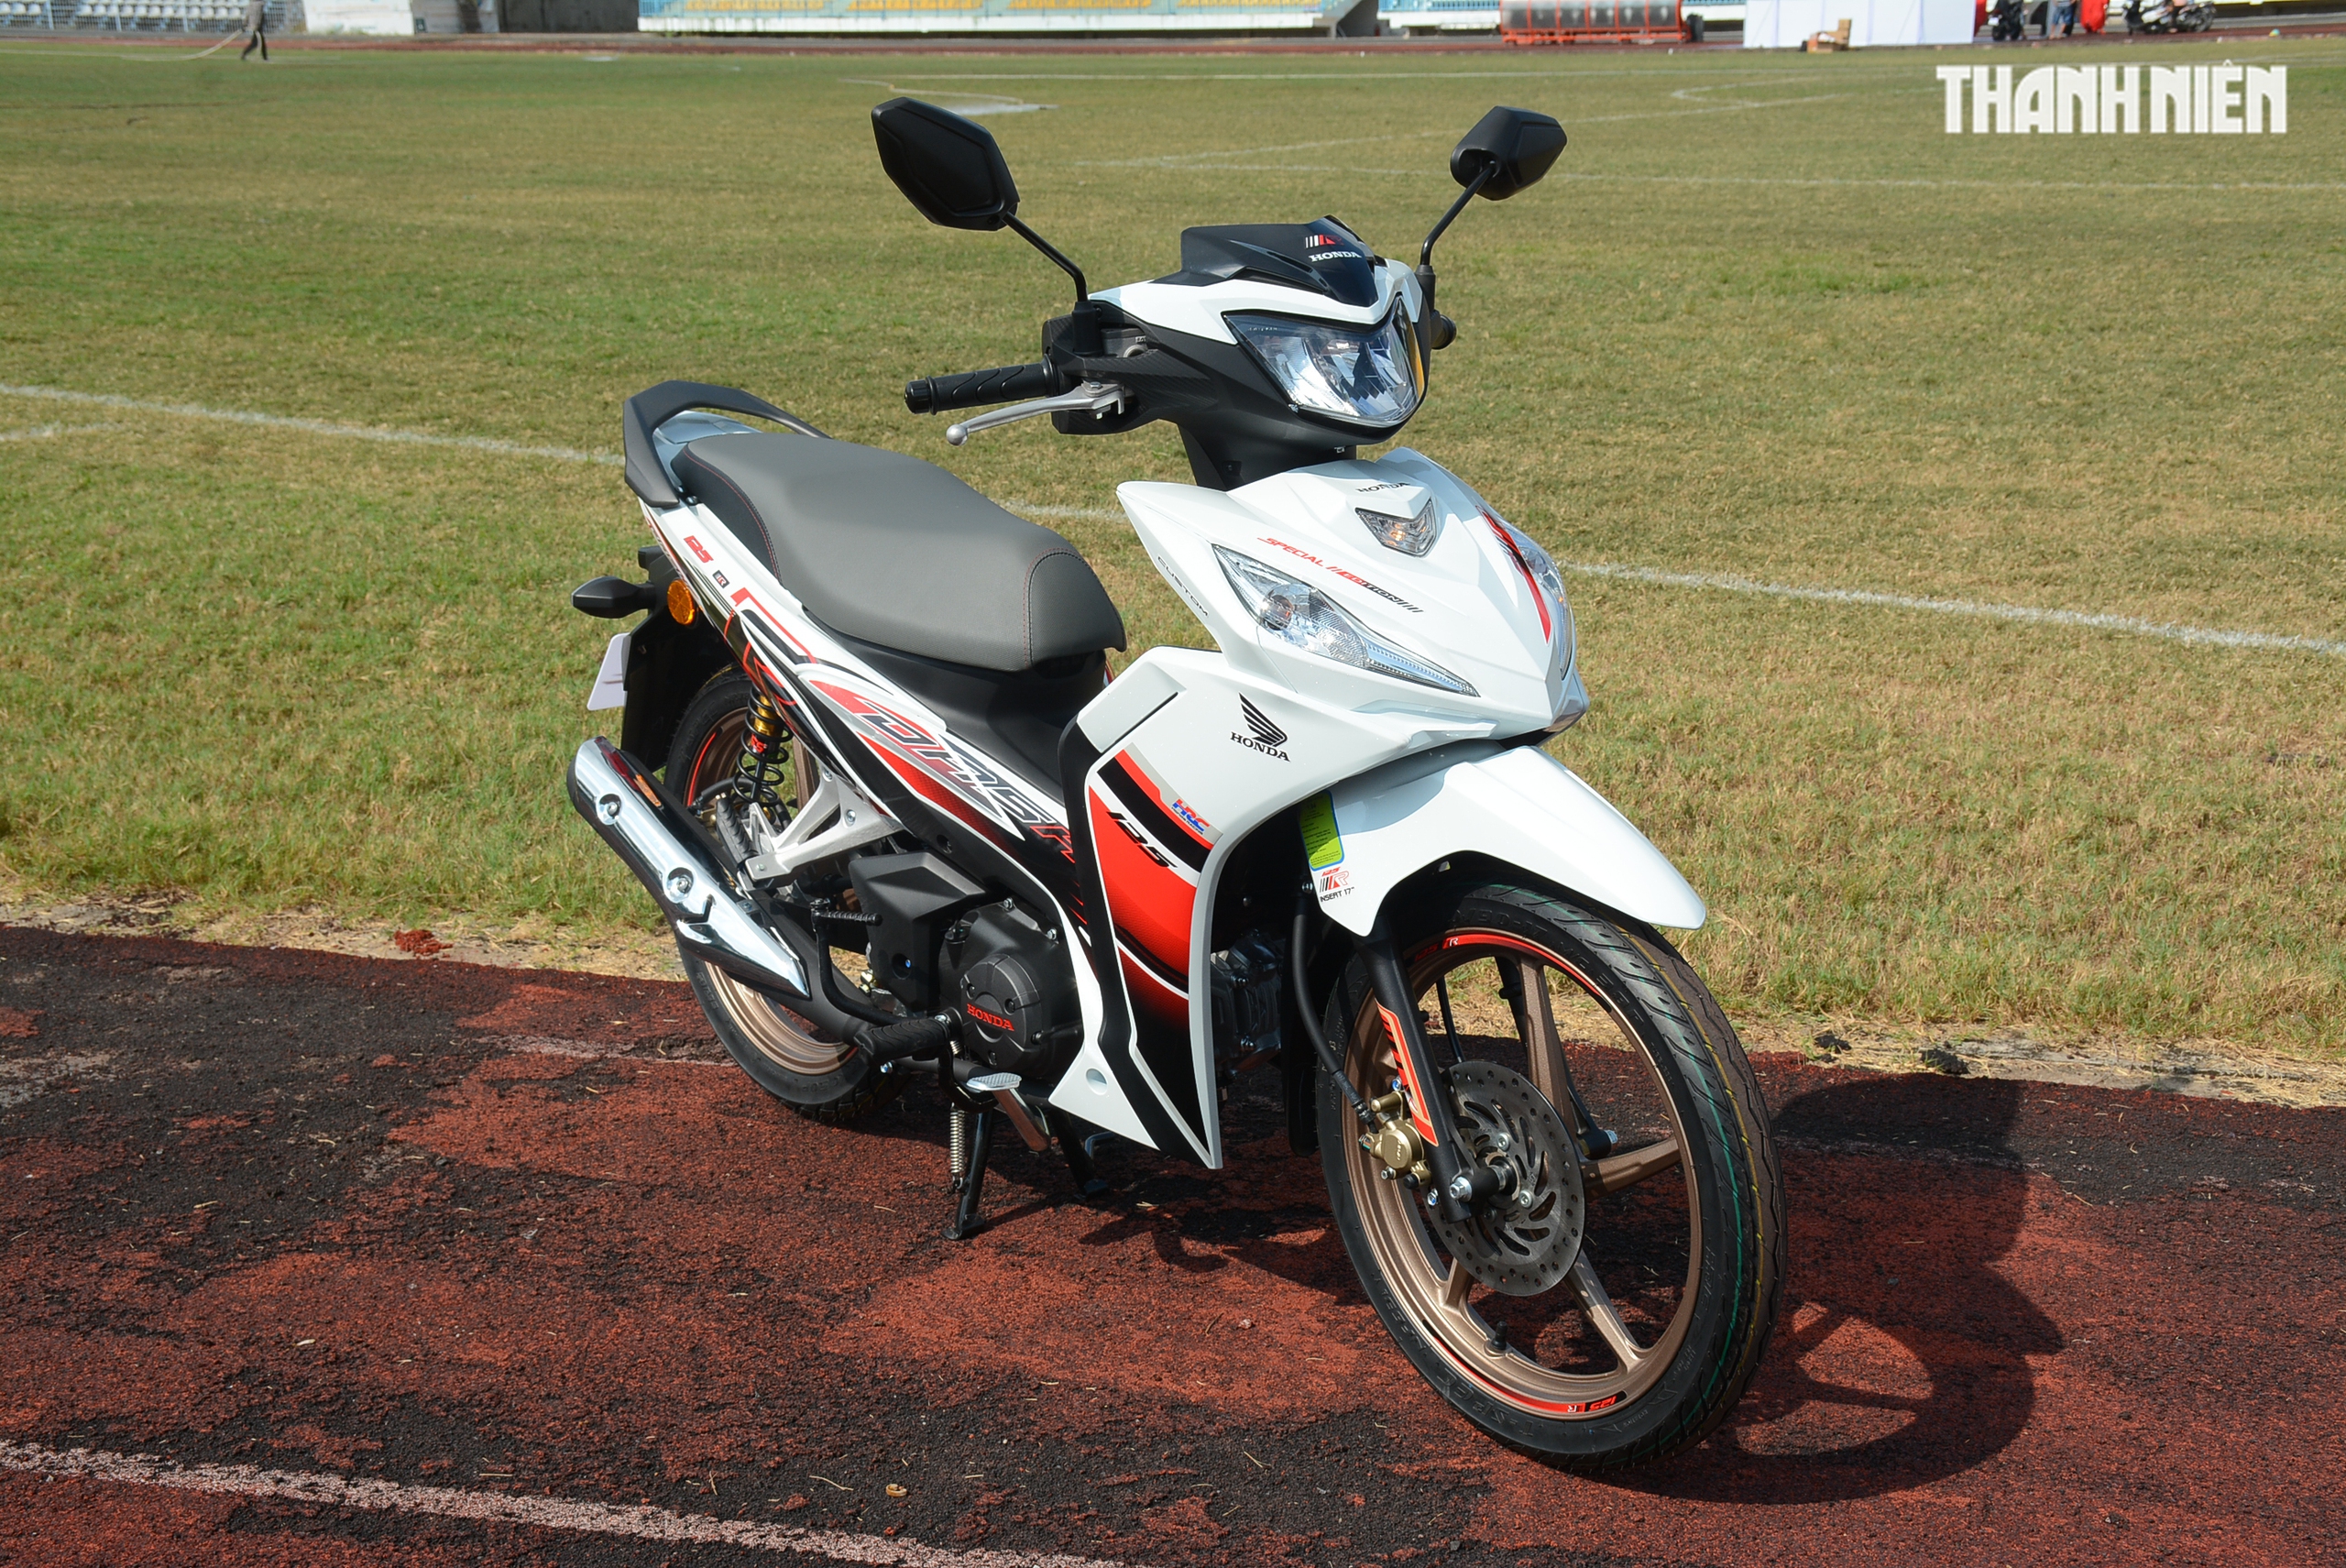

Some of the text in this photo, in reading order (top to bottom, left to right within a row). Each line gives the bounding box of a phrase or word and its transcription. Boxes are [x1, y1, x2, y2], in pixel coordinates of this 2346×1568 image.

[1309, 250, 1362, 262] HONDA
[1355, 482, 1410, 492] HONDA
[684, 535, 714, 563] 125
[1258, 537, 1323, 566] SPECIAL
[1157, 556, 1208, 616] CUSTOM
[1230, 731, 1290, 762] HONDA
[1173, 799, 1210, 831] HRC
[1105, 811, 1178, 868] 125
[1320, 890, 1343, 902] INSERT
[1449, 937, 1459, 947] R
[967, 1003, 1014, 1031] HONDA
[1567, 1396, 1617, 1413] 125 R
